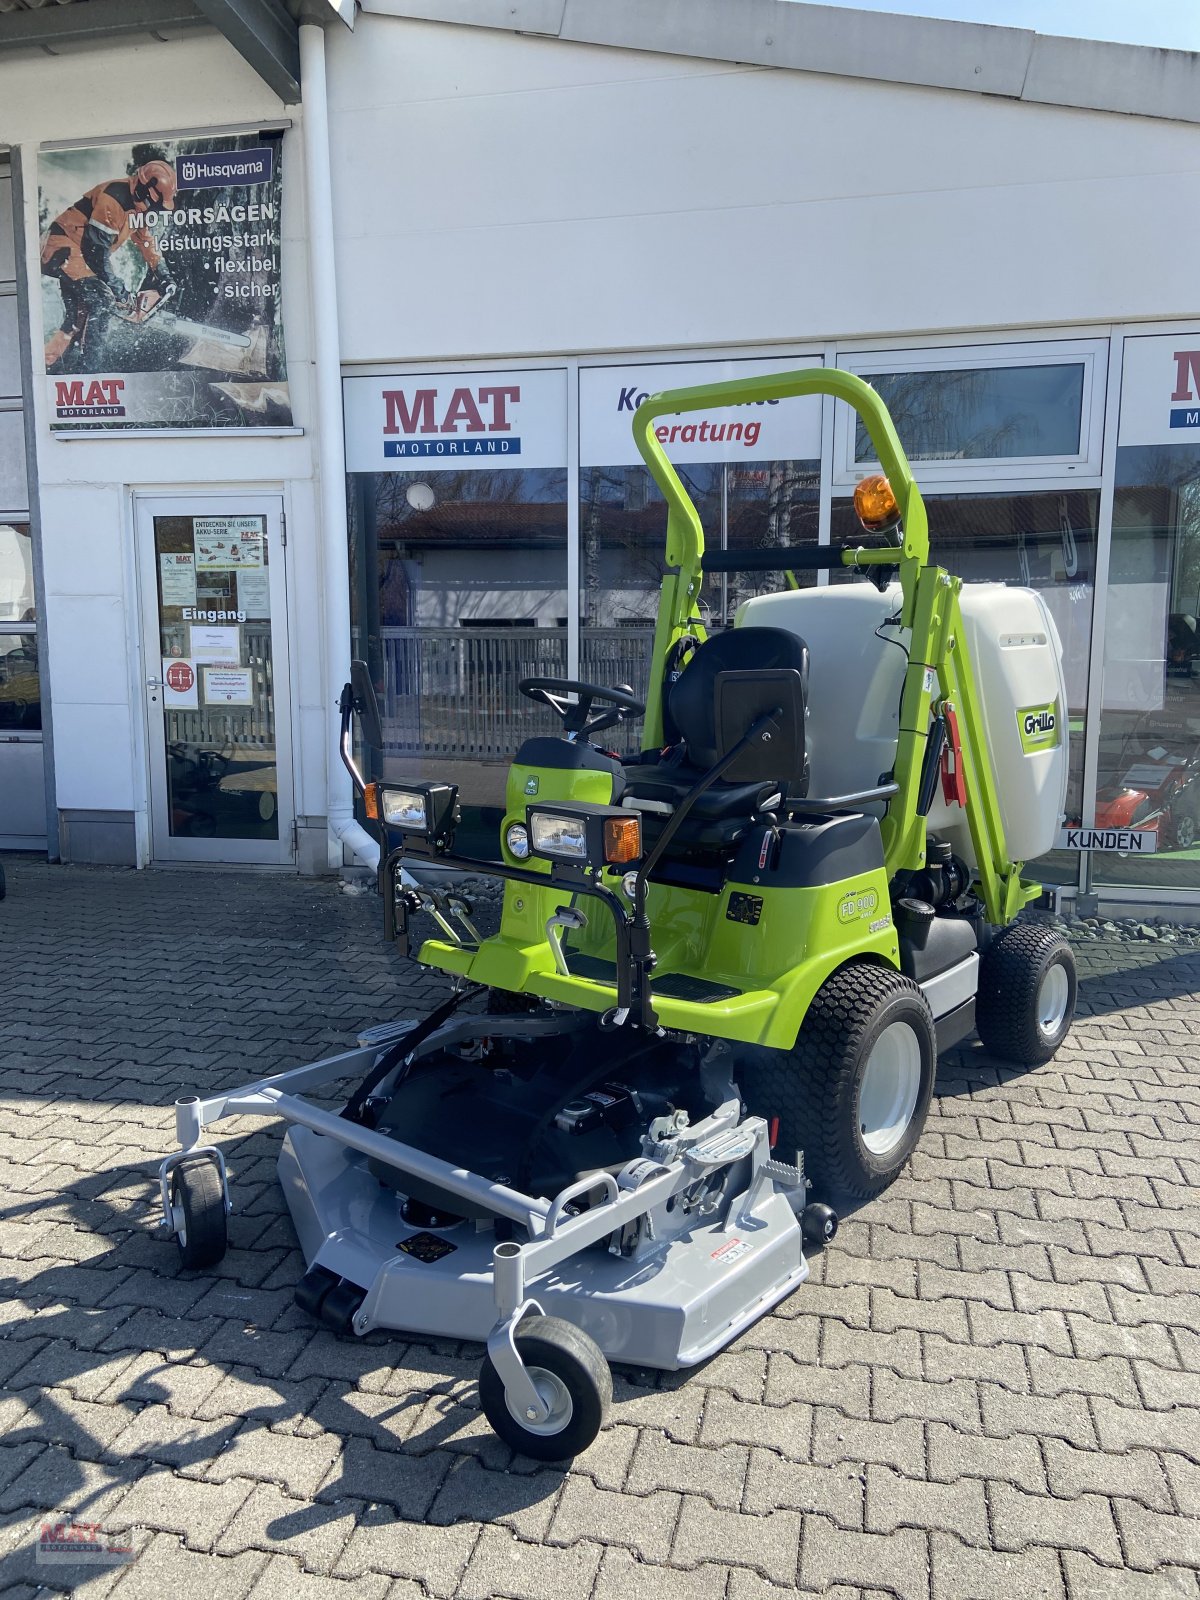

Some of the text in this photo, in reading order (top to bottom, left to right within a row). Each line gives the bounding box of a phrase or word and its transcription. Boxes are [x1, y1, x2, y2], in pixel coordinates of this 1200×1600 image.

[196, 160, 264, 179] Husqvarna
[128, 202, 274, 229] MOTORSÄGEN
[154, 230, 275, 252] leistungsstark
[214, 255, 276, 273] flexibel
[224, 281, 278, 298] sicher
[55, 379, 125, 406] MAT
[62, 408, 119, 416] MOTORLAND
[382, 386, 520, 435] MAT
[653, 420, 762, 447] eratung
[395, 440, 510, 456] MOTORLAND
[182, 607, 247, 623] Eingang
[1024, 711, 1055, 736] Grillo
[1067, 831, 1142, 850] KUNDEN
[857, 894, 875, 911] 900
